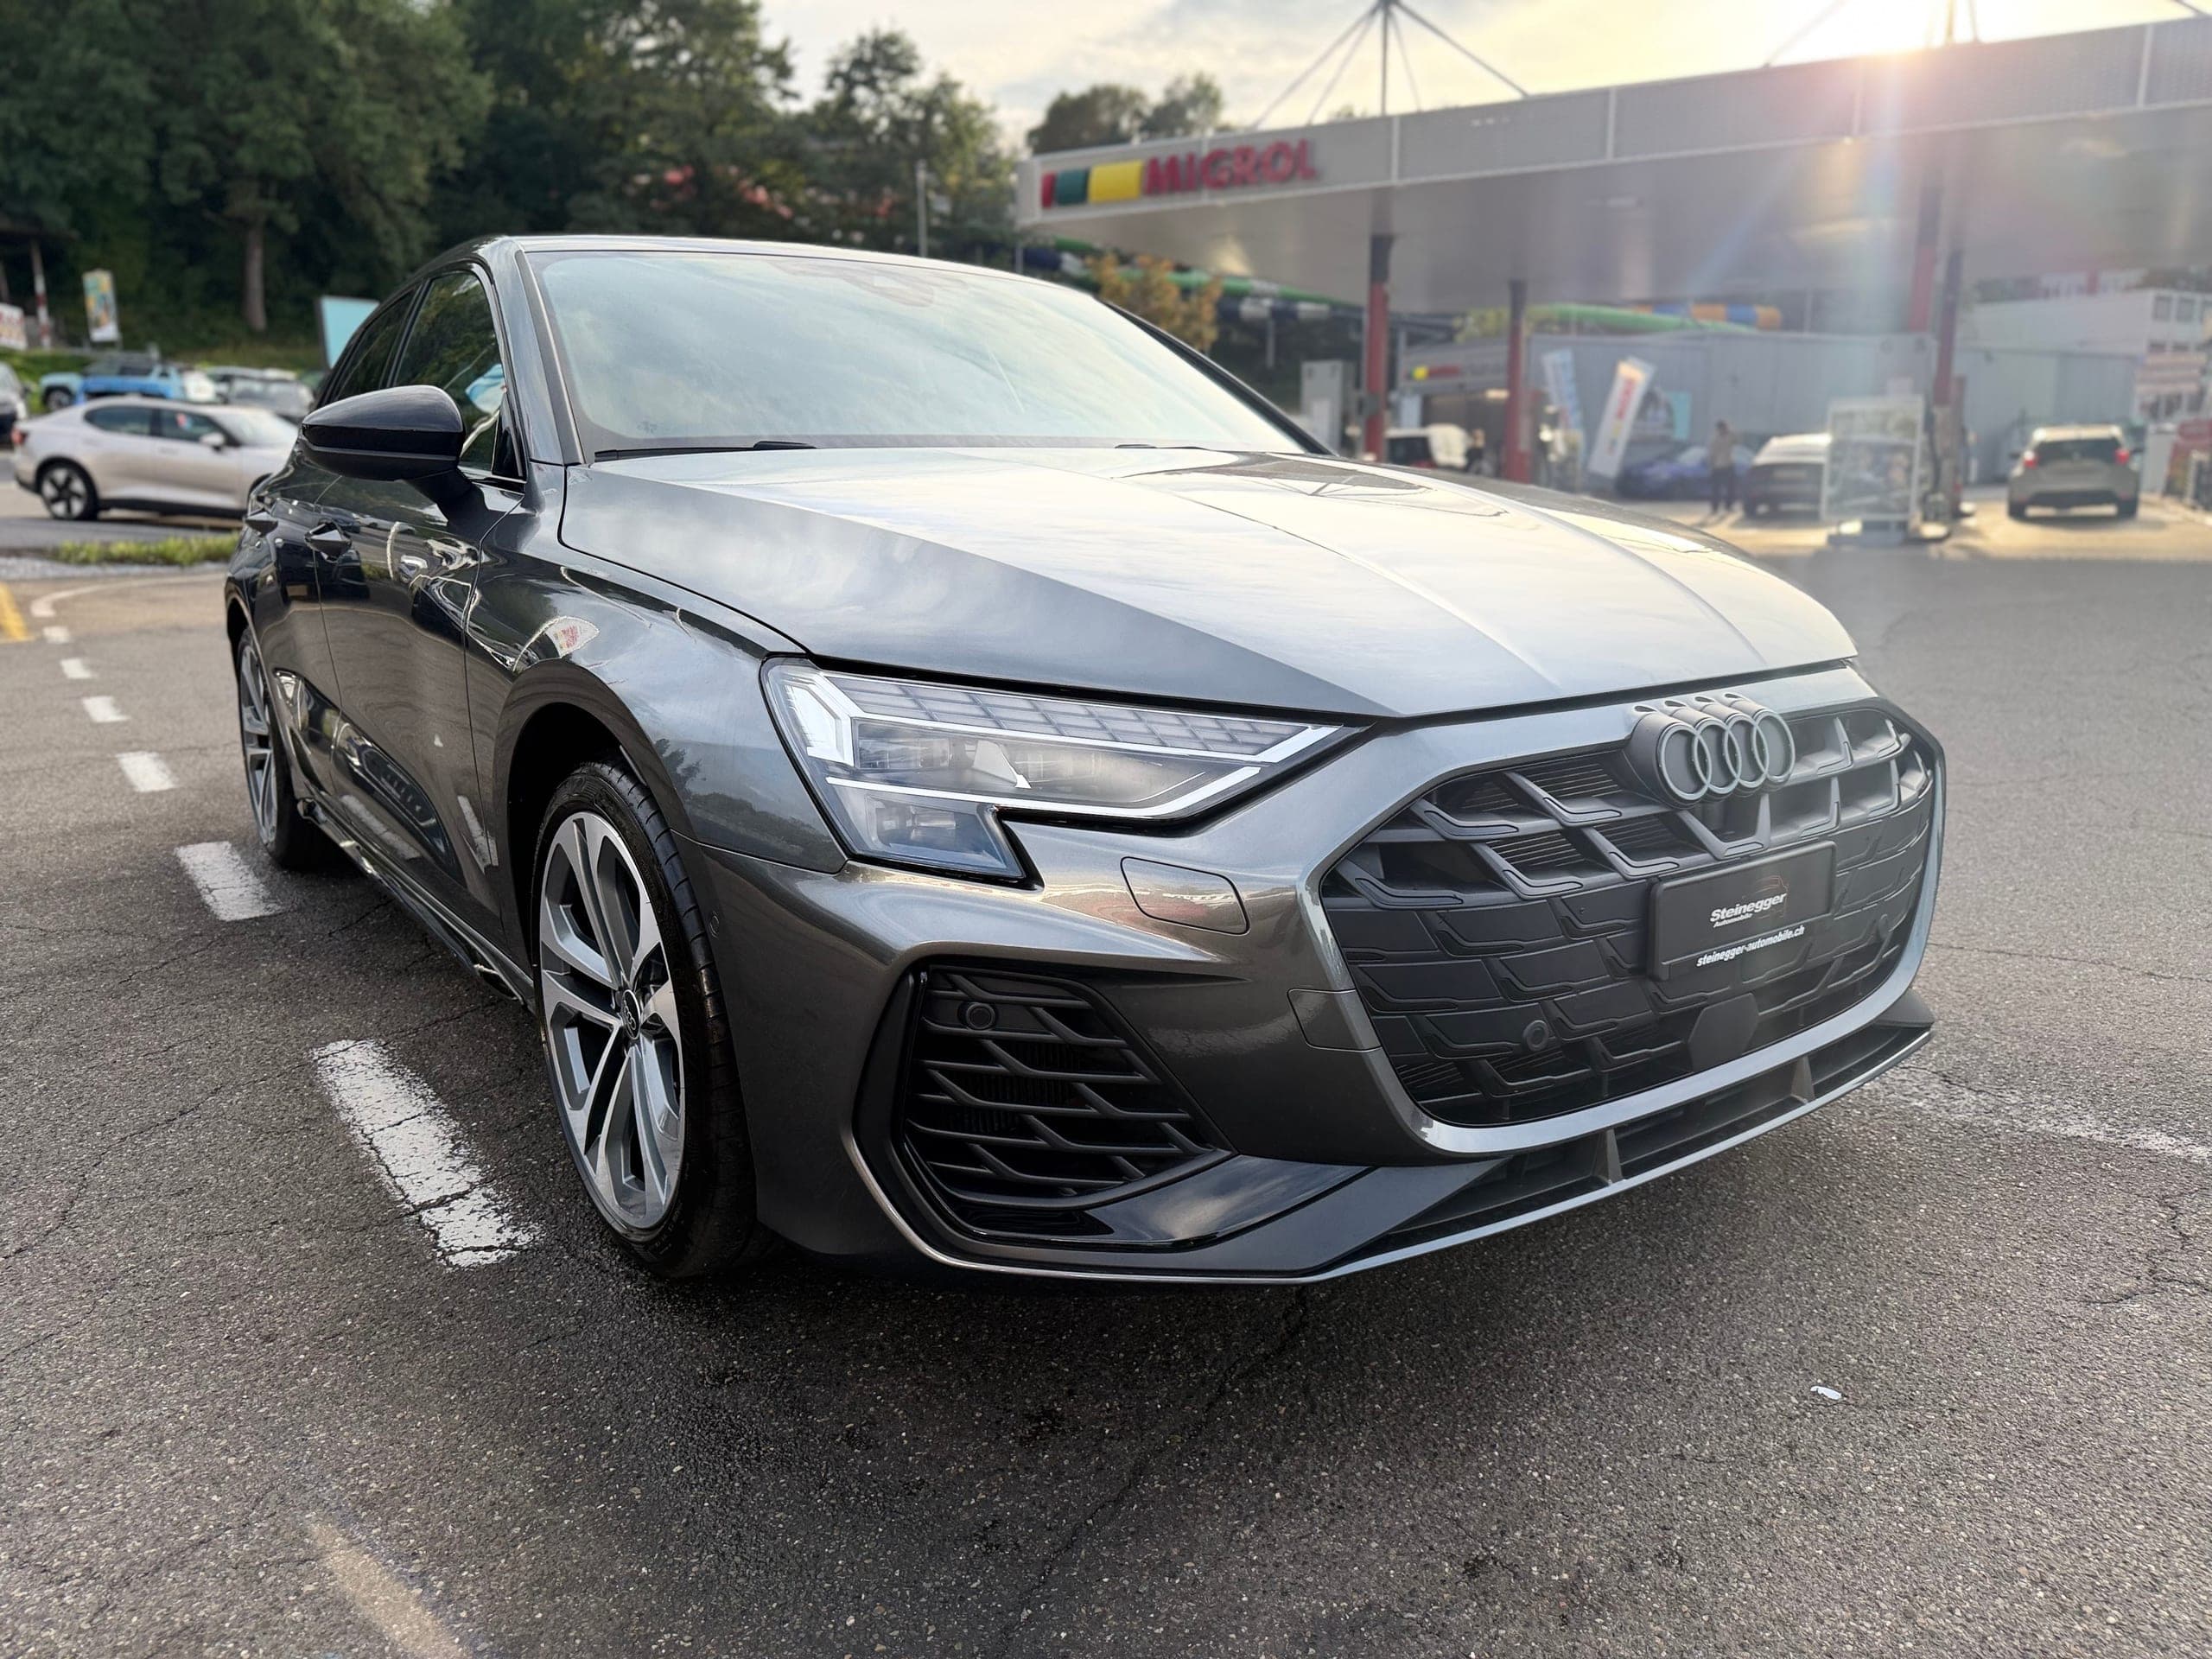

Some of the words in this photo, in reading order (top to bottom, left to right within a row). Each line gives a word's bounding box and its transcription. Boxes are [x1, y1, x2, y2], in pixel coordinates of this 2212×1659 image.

[1142, 138, 1318, 196] MIGROL
[1710, 893, 1787, 922] Steinegger
[1696, 925, 1805, 967] steinegger-automobile.ch
